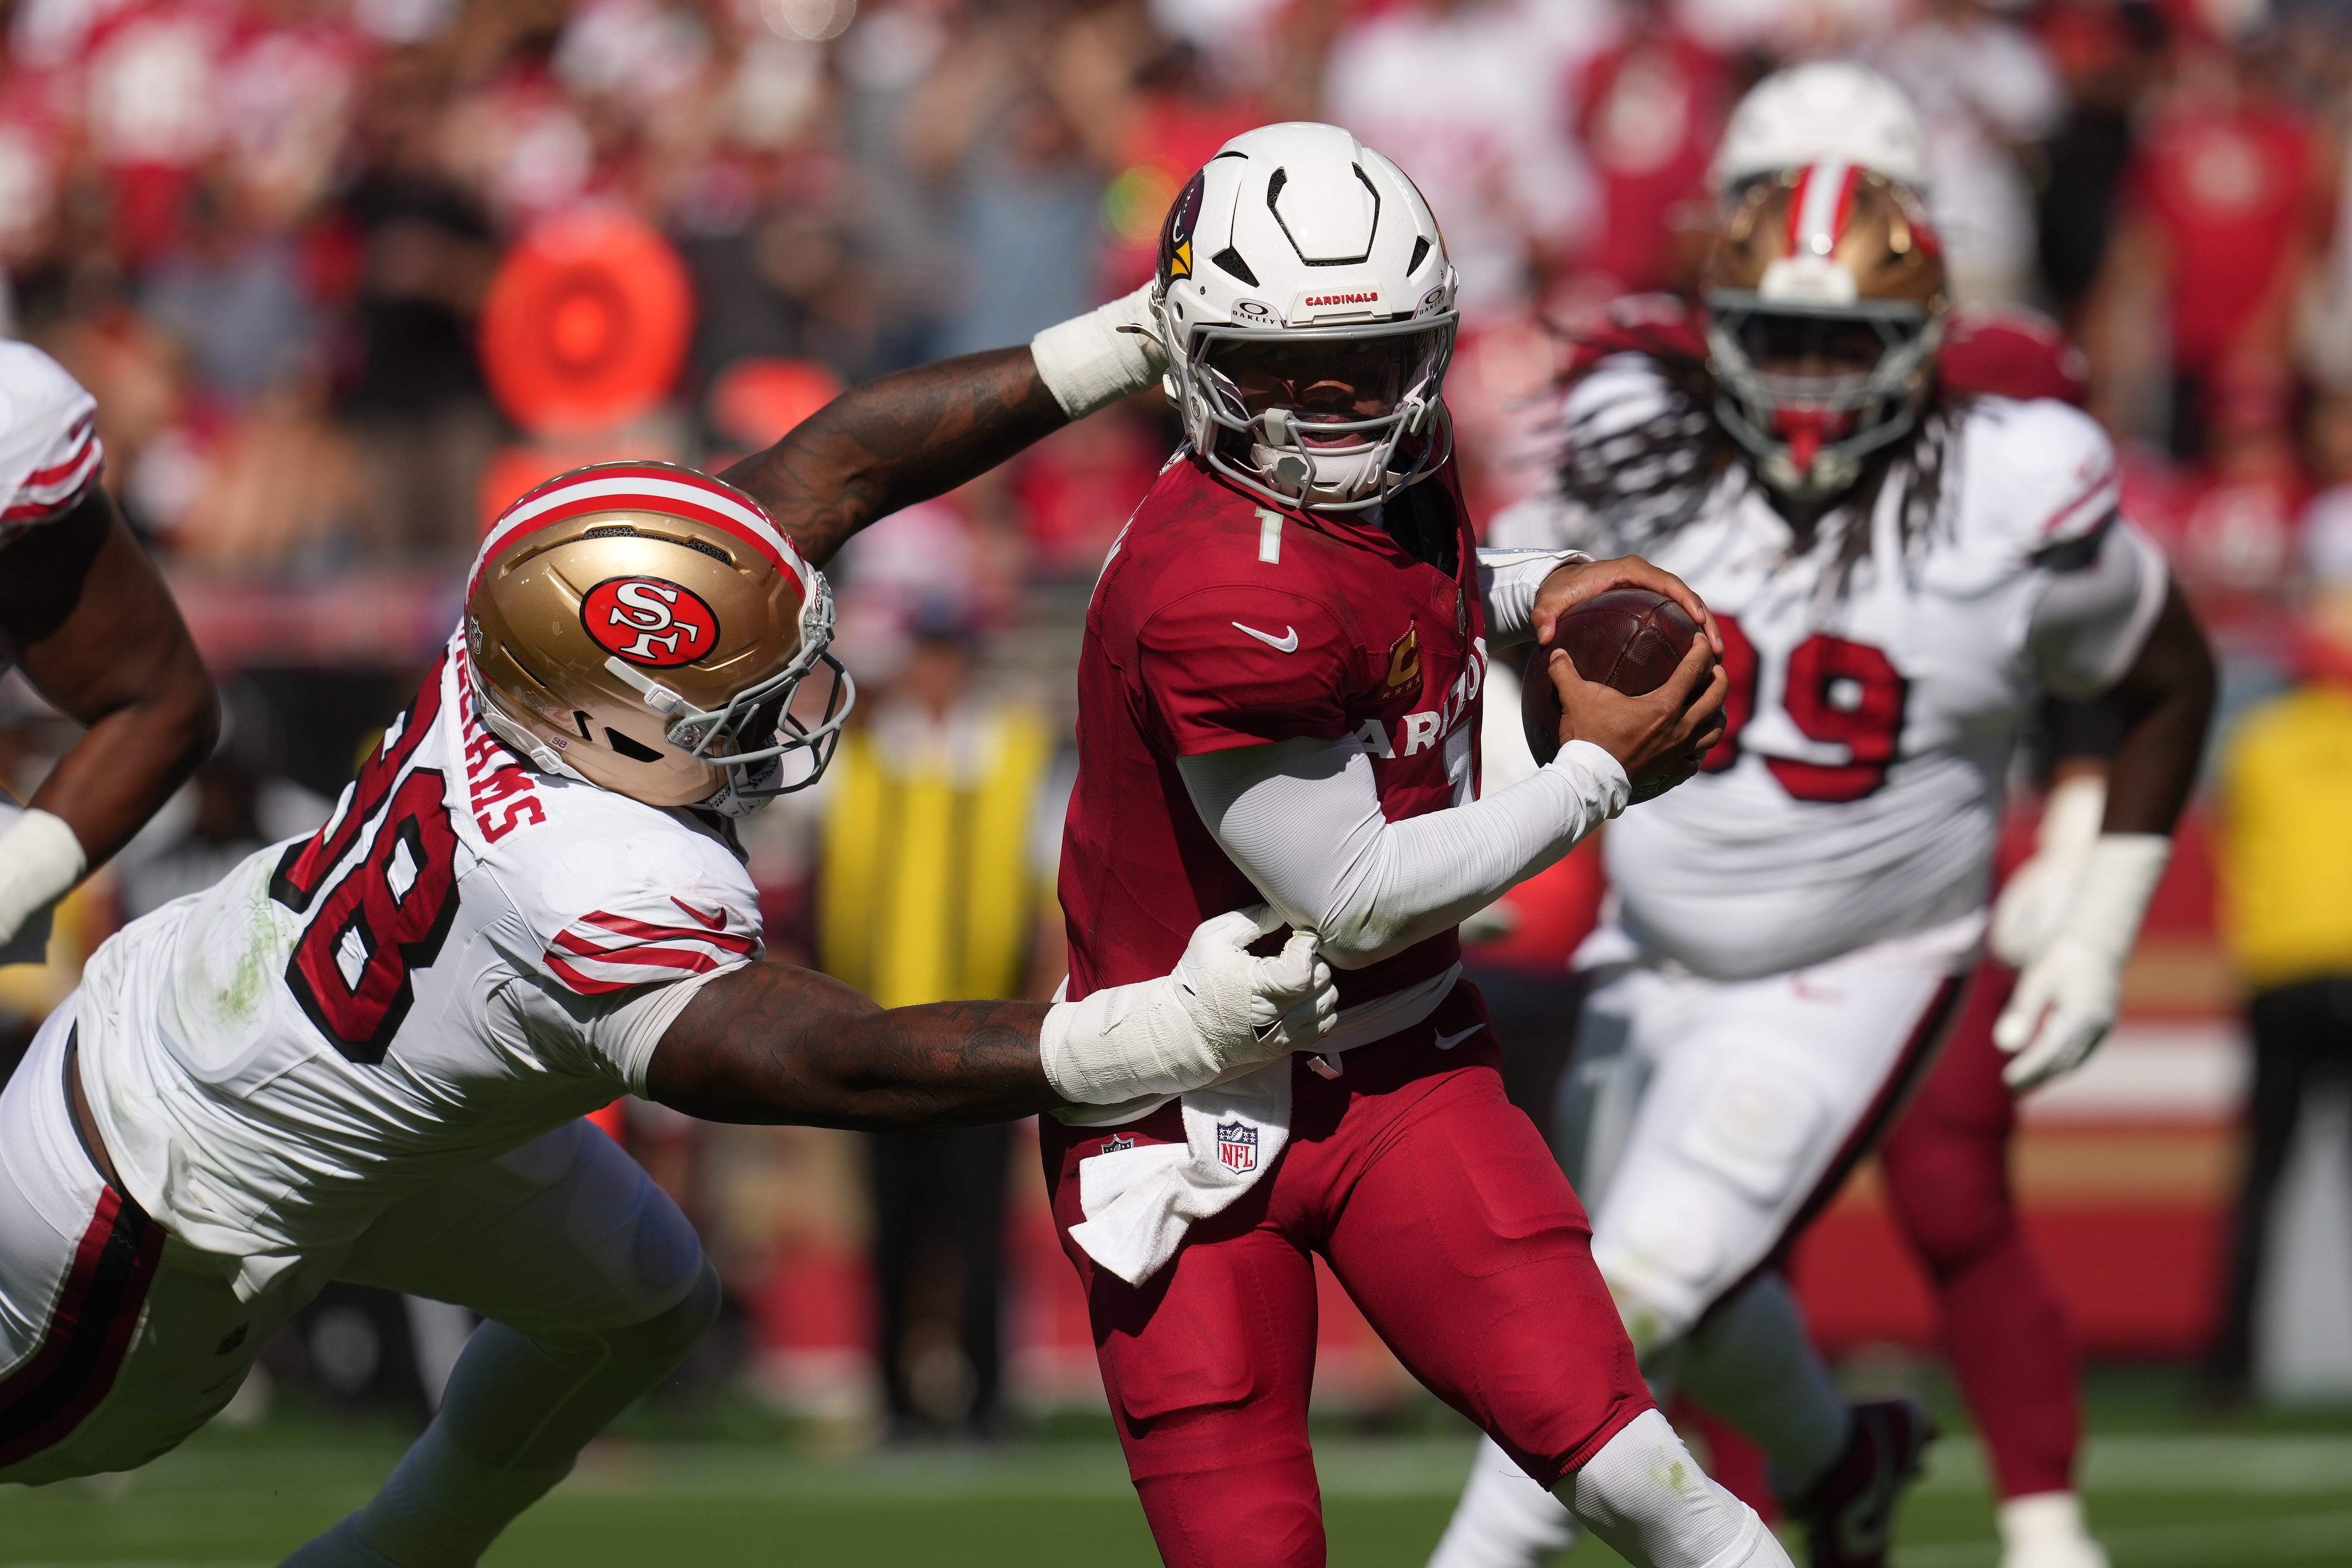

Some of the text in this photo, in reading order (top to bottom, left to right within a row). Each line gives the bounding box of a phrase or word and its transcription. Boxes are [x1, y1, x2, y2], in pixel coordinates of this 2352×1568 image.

[1306, 292, 1378, 306] CARDINALS
[1420, 296, 1444, 315] OAKLEY
[1233, 311, 1275, 324] OAKLEY
[1255, 507, 1284, 564] 1
[608, 582, 699, 660] SF
[1387, 630, 1419, 687] C
[552, 737, 568, 749] 98
[1221, 1143, 1253, 1169] NFL
